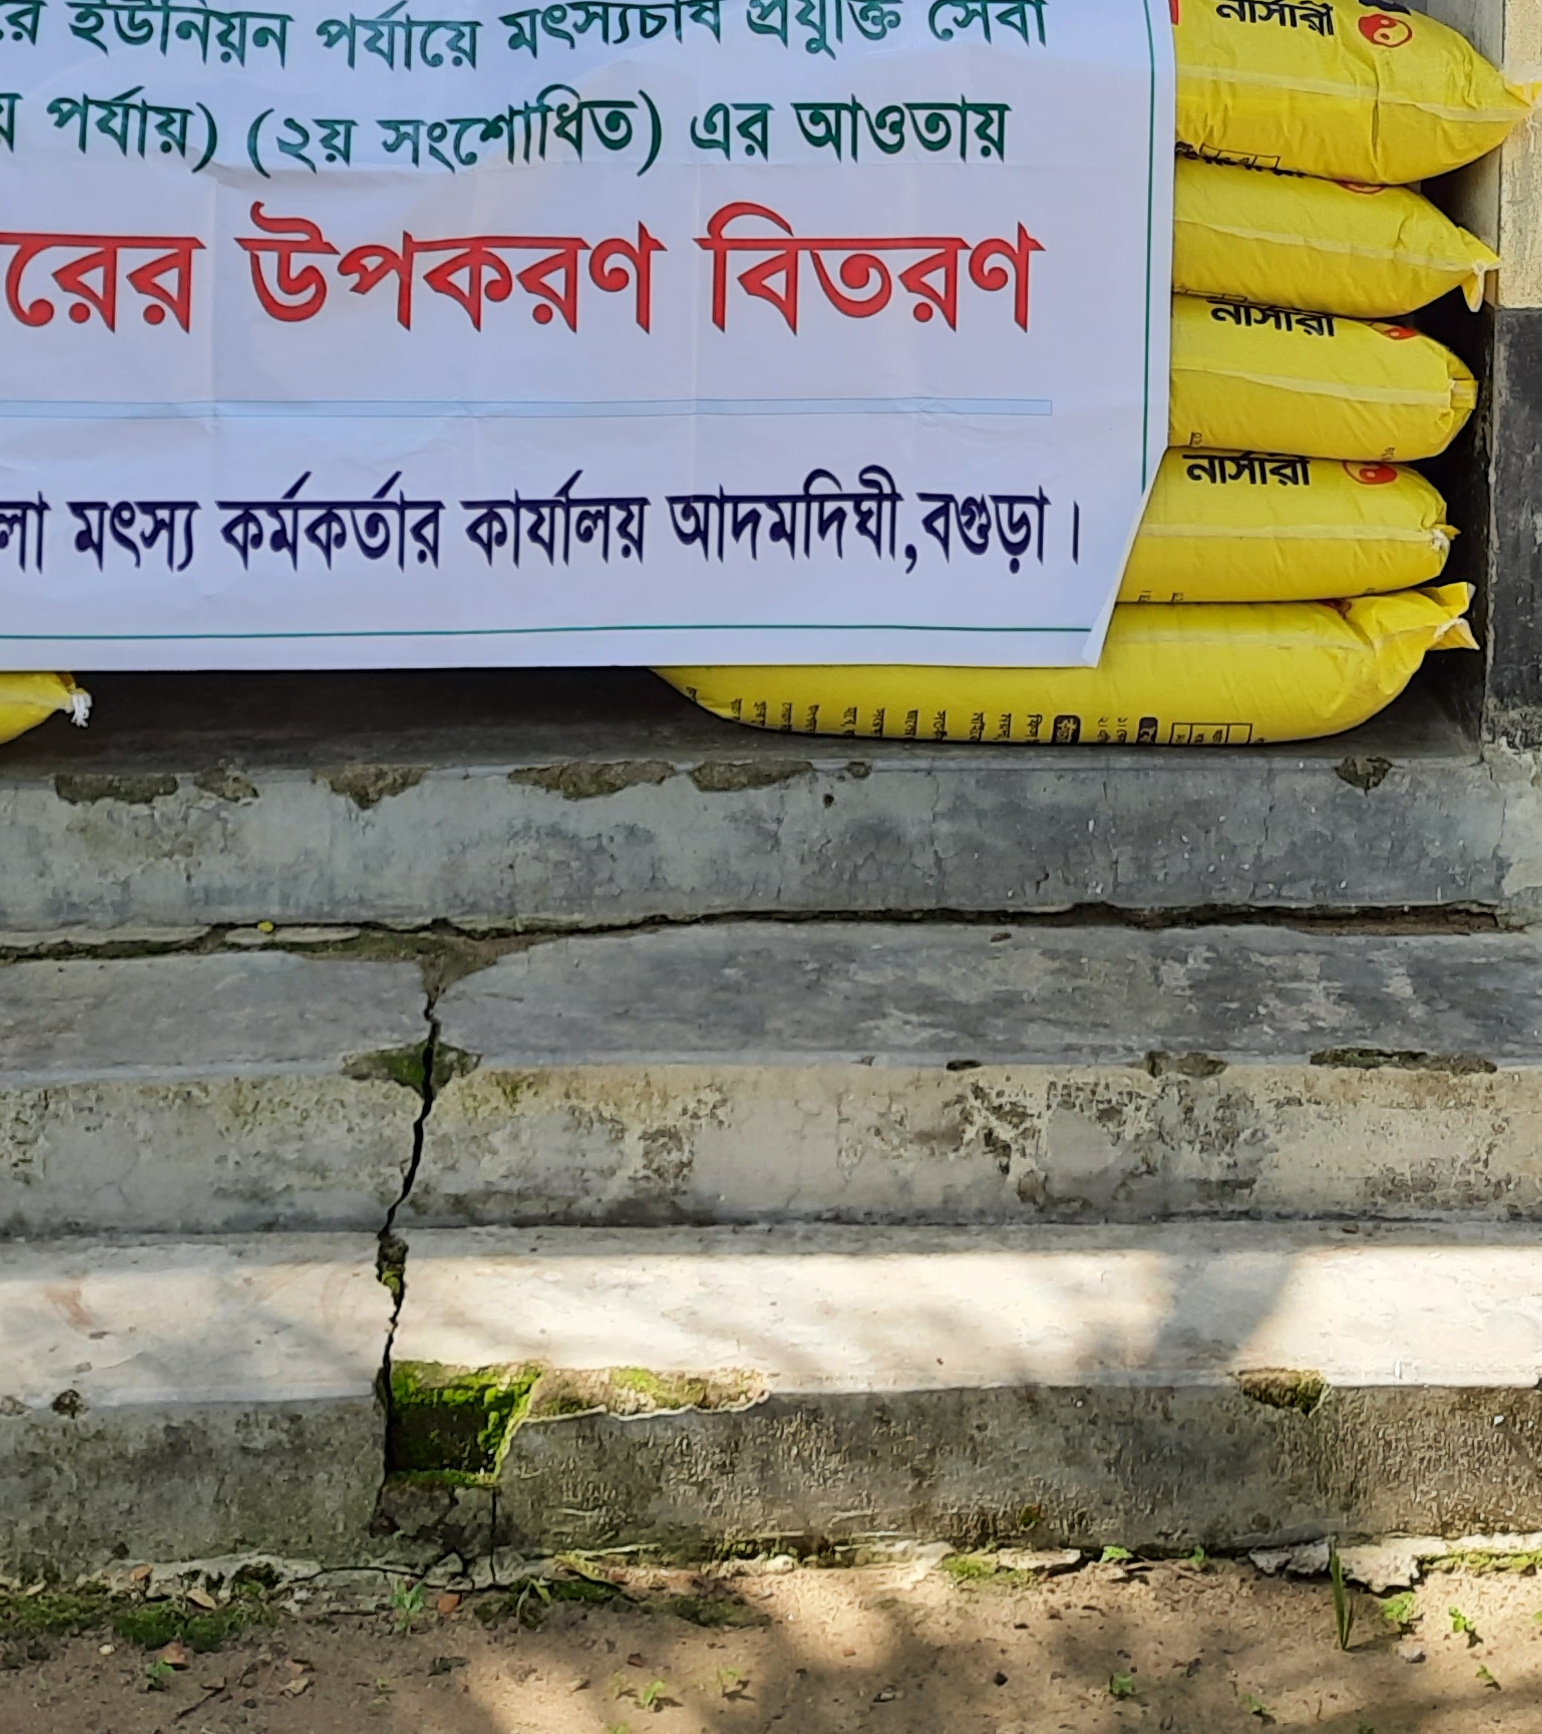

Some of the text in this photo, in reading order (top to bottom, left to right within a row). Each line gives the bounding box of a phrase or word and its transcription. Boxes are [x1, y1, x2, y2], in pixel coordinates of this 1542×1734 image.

[316, 0, 483, 70] পর্যায়ে
[47, 86, 218, 173] পর্যায়)
[247, 108, 357, 179] (২য়
[376, 84, 662, 177] সংশোধিত)
[690, 103, 774, 162] এর
[790, 94, 1012, 162] আওতায়
[234, 201, 667, 334] উপকরণ
[694, 202, 1045, 335] বিতরণ
[66, 498, 201, 571] মৎস্য
[215, 471, 446, 571] কর্মকর্তার
[460, 470, 651, 567] কার্যালয়
